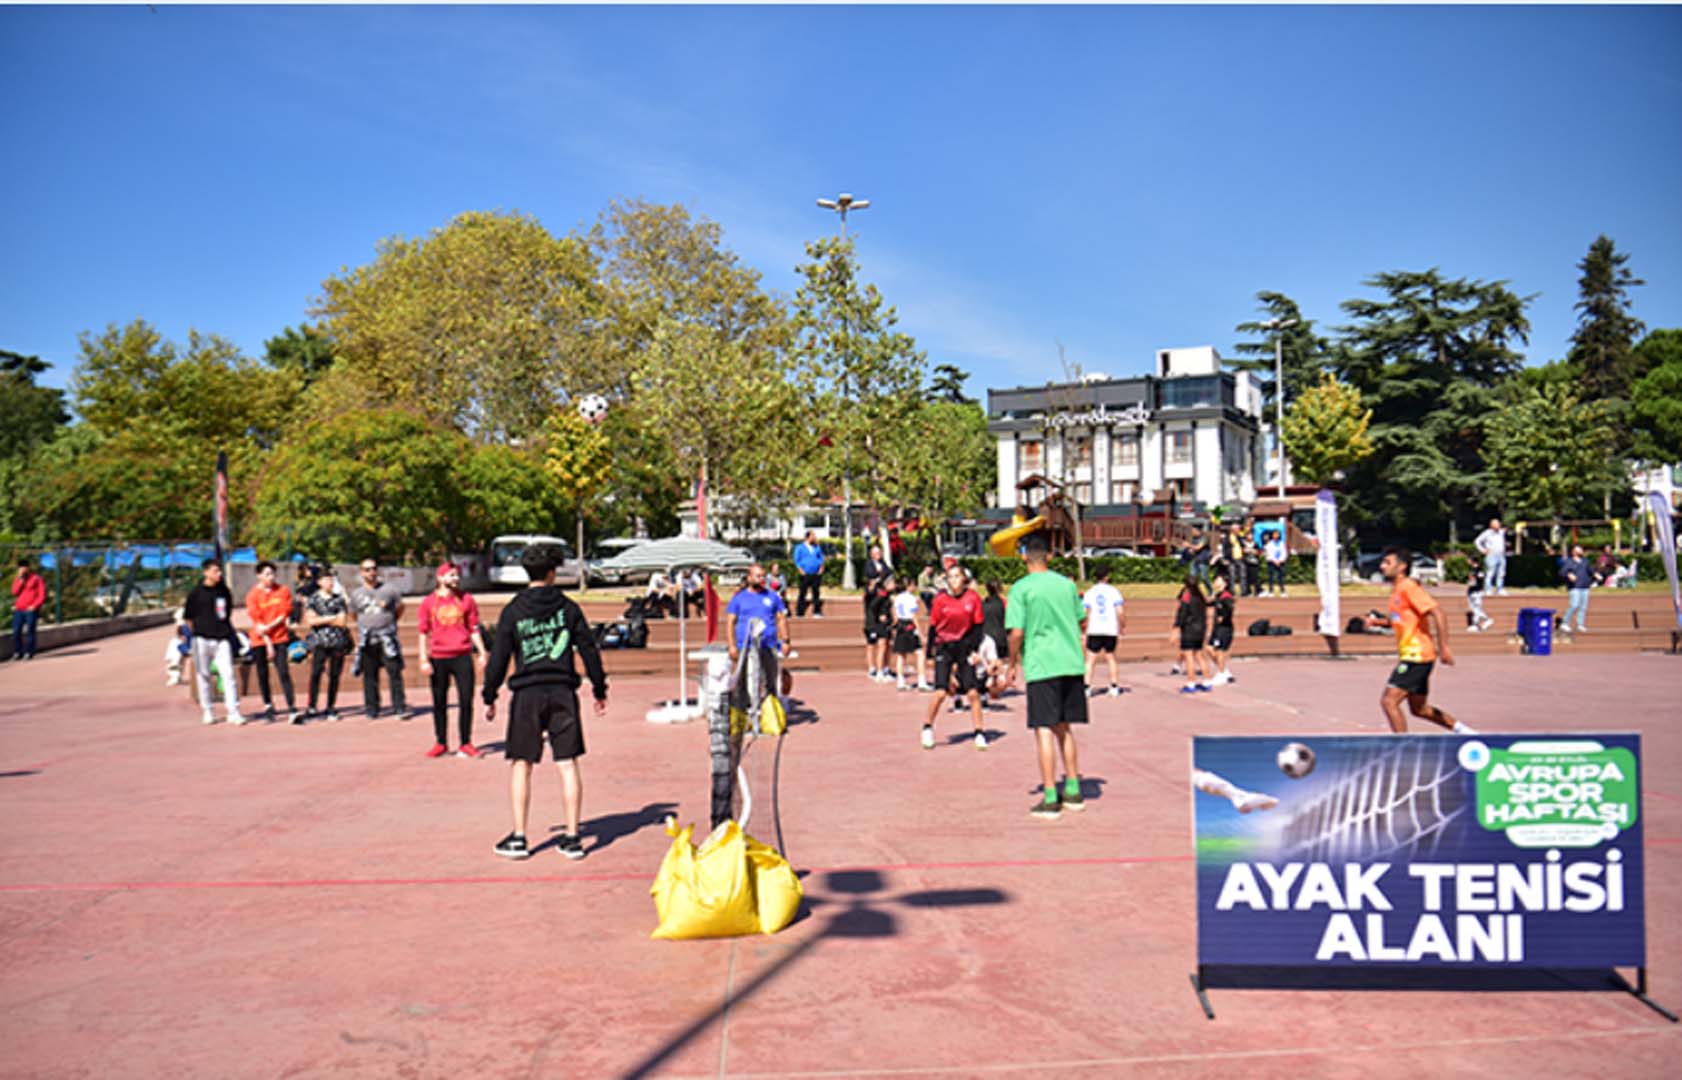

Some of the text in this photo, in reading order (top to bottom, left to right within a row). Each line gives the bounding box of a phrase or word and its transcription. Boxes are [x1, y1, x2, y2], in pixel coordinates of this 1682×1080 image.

[1487, 762, 1625, 783] AVRUPA
[1508, 783, 1604, 803] SPOR
[1485, 803, 1629, 824] HAFTASI
[1216, 849, 1624, 911] AYAK TENİSİ
[1315, 914, 1524, 962] ALANI
